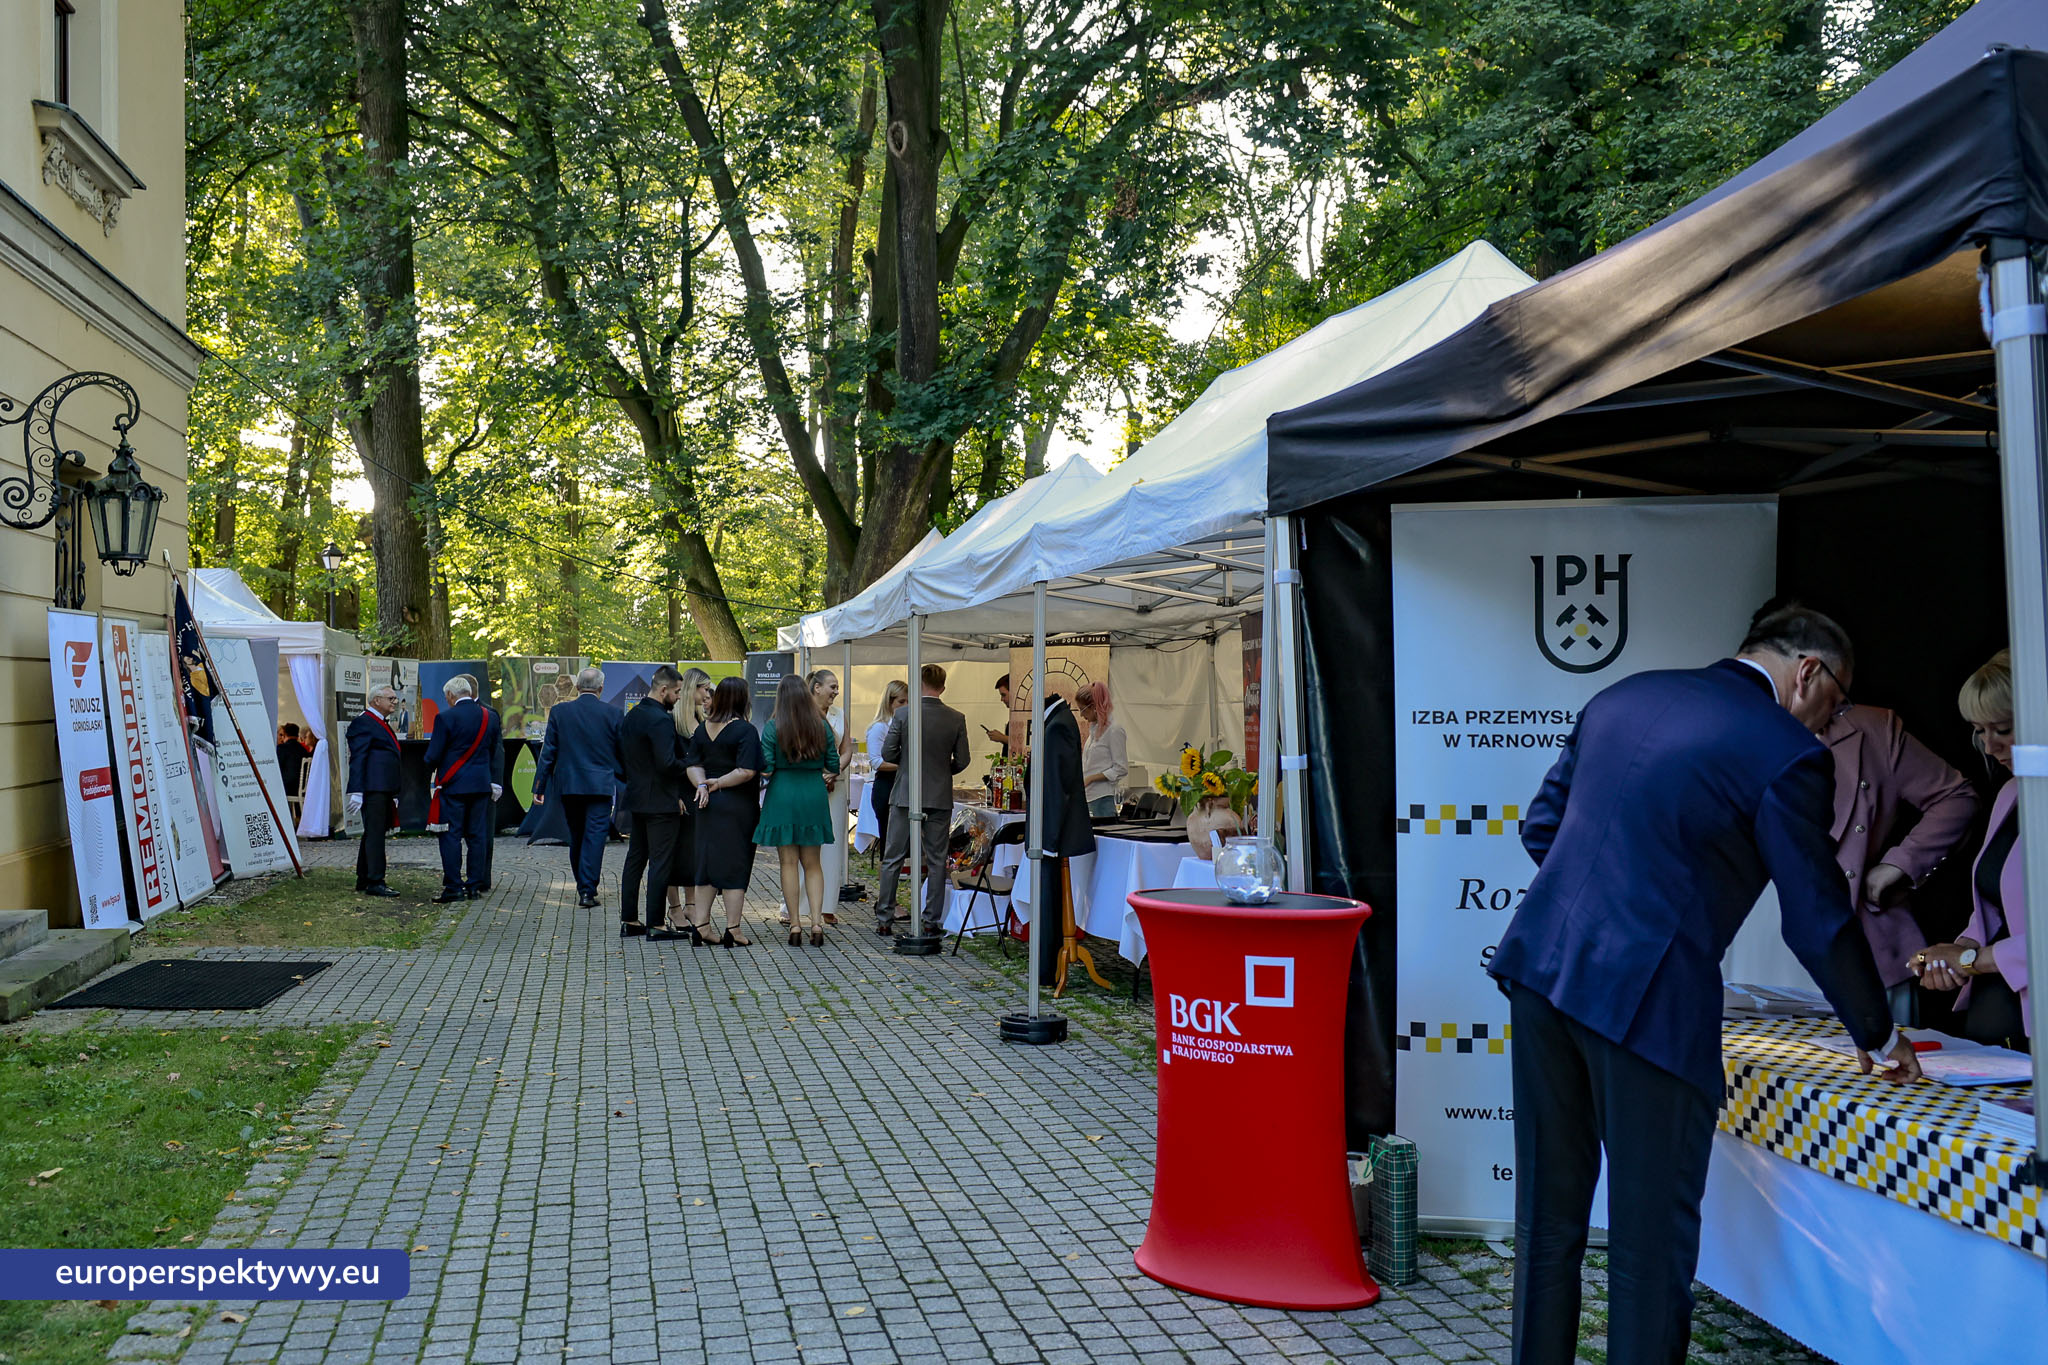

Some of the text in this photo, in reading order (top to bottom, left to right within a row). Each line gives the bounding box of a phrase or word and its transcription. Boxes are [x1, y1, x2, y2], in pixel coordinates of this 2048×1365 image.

[1529, 553, 1633, 596] IPH
[1088, 635, 1106, 643] PIWO
[344, 670, 362, 680] EURO
[69, 697, 102, 714] FUNDUSZ
[1412, 710, 1459, 725] IZBA
[140, 711, 150, 748] THE
[1443, 733, 1462, 748] W
[117, 650, 161, 902] REMONDIS
[145, 756, 156, 793] FOR
[151, 803, 170, 899] WORKING
[1169, 993, 1242, 1036] BGK
[1171, 1032, 1294, 1056] BANK GOSPODARSTWA
[1171, 1044, 1235, 1064] KRAJOWEGO
